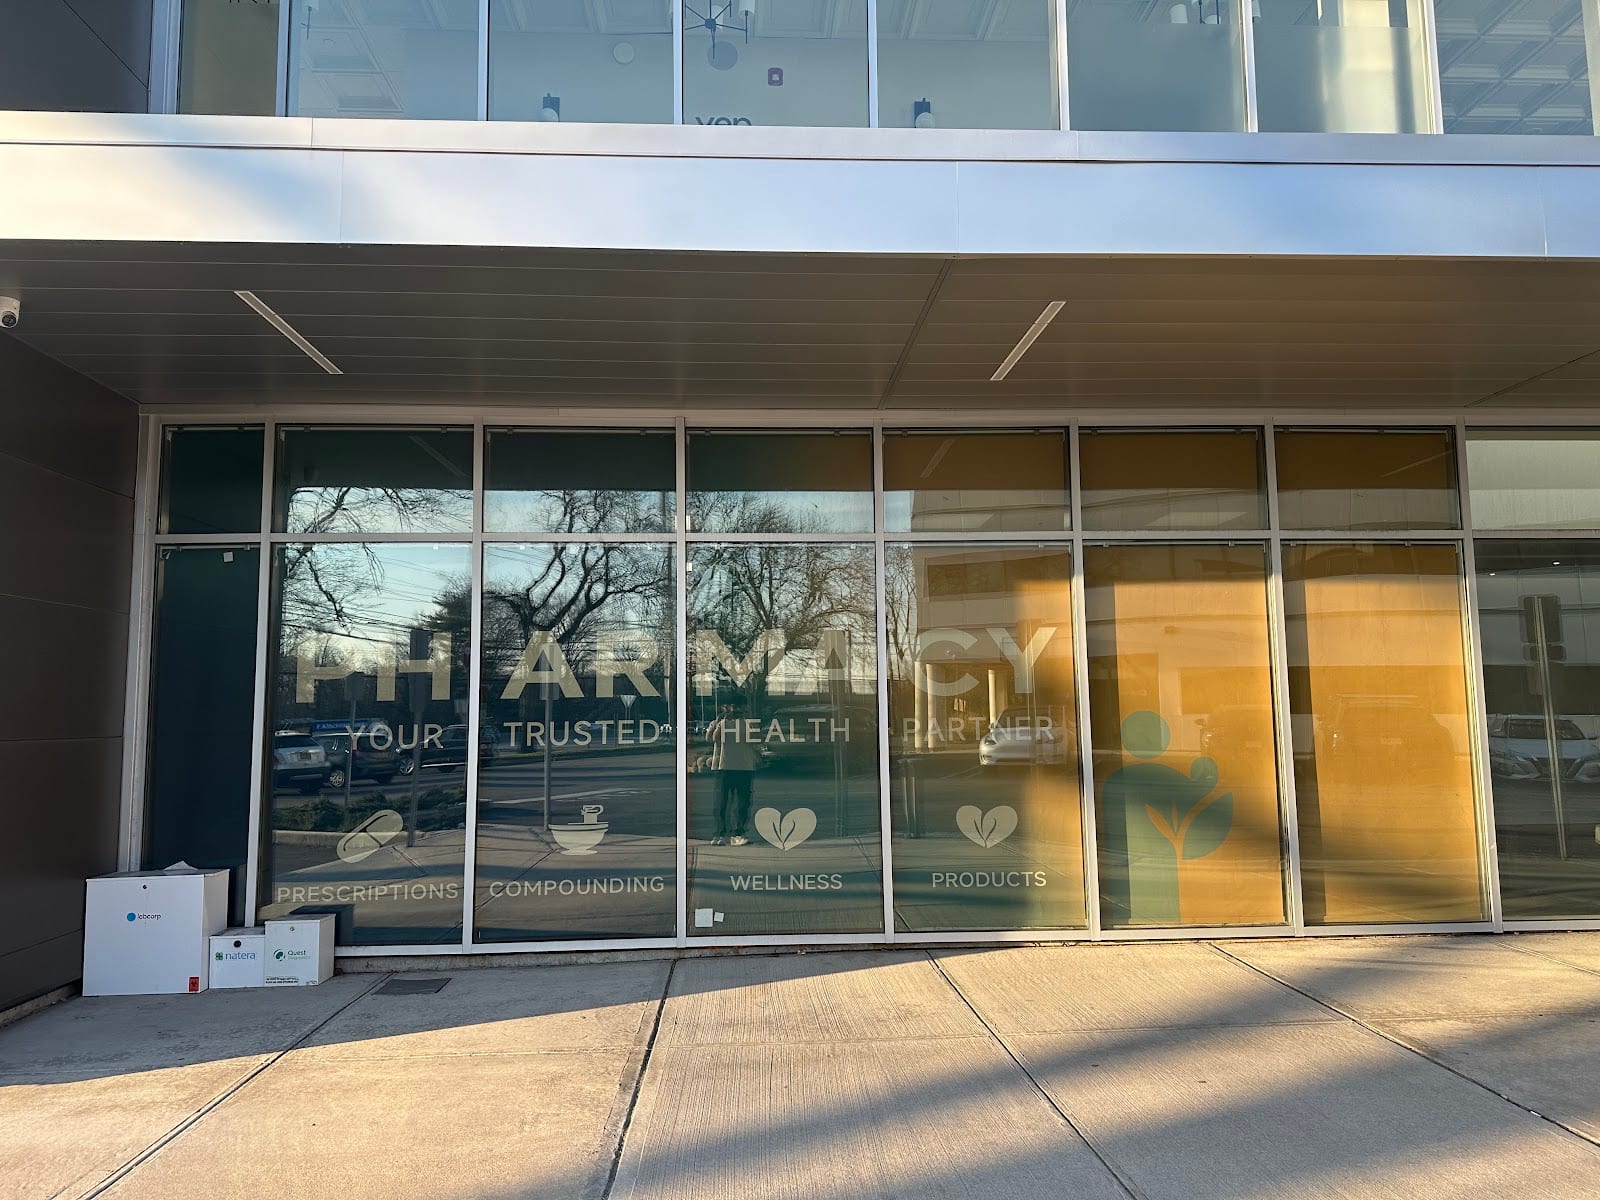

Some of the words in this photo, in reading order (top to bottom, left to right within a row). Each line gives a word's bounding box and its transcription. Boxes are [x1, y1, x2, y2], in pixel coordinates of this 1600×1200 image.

[296, 627, 1056, 703] PHARMACY
[345, 723, 444, 751] YOUR
[504, 719, 661, 748] TRUSTED
[720, 717, 851, 743] HEALTH
[902, 716, 1055, 743] PARTNER
[489, 876, 665, 898] COMPOUNDING
[730, 873, 843, 891] WELLNESS
[931, 871, 1047, 889] PRODUCTS
[276, 882, 459, 903] PRESCRIPTIONS
[225, 951, 256, 960] natera
